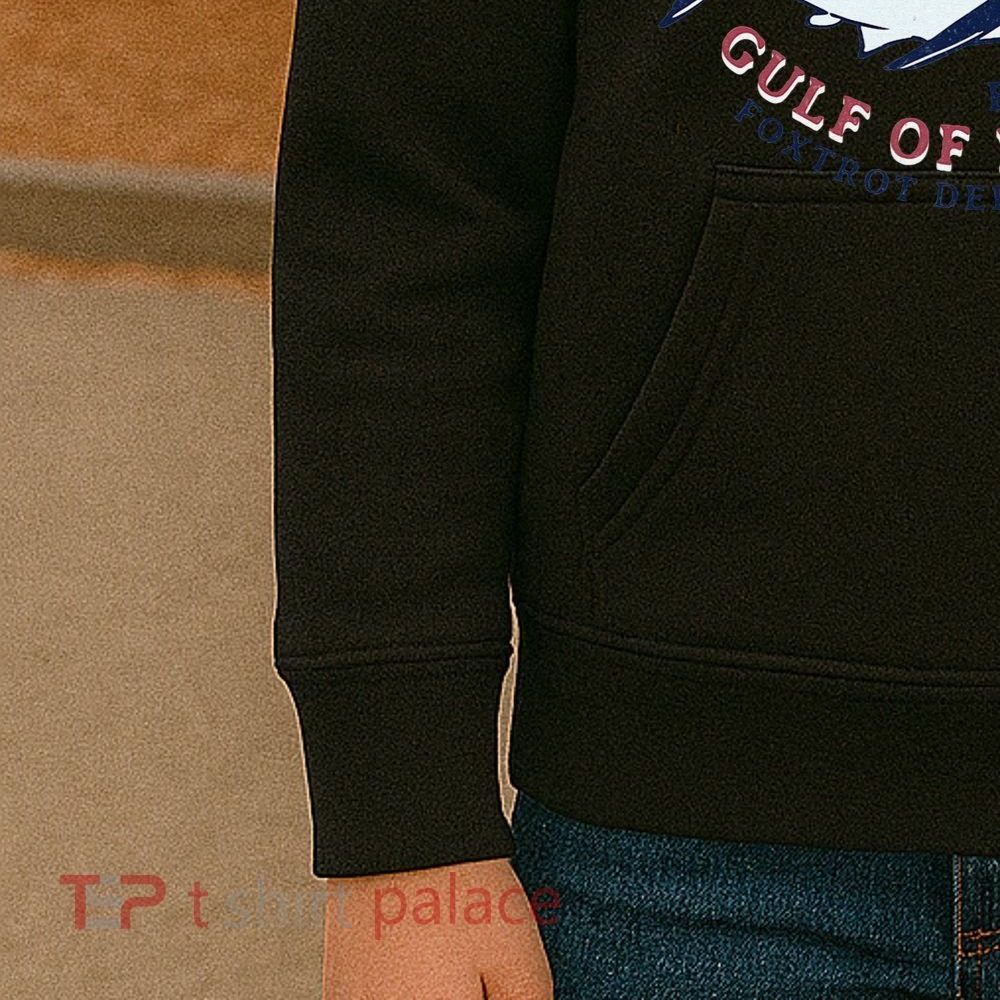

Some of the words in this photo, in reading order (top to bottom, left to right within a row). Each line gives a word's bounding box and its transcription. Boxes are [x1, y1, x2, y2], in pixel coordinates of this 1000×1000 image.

[721, 25, 872, 144] GULF
[889, 117, 971, 173] OF
[734, 97, 919, 204] FOXTROT
